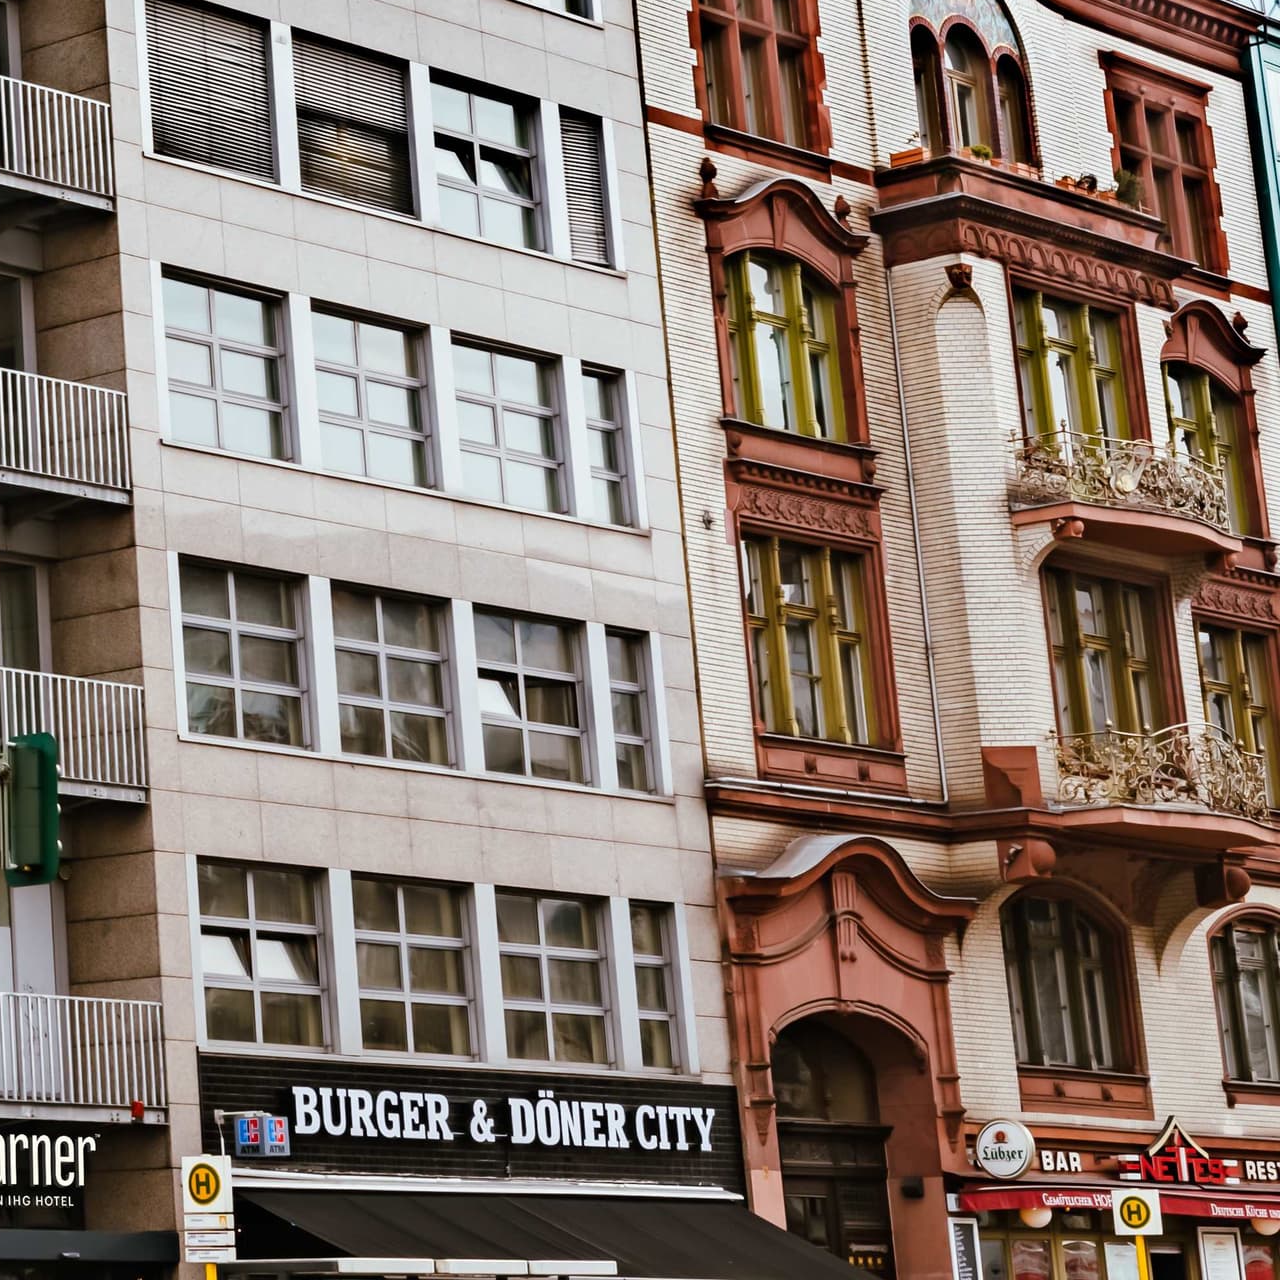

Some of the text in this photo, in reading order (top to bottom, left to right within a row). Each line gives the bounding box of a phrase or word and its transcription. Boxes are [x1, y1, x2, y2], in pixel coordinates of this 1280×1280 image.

[291, 1085, 716, 1152] BURGER & DÖNER CITY
[240, 1144, 260, 1154] ATM
[269, 1144, 286, 1154] ATM
[982, 1146, 1024, 1162] Lübzer
[1041, 1150, 1082, 1173] BAR
[195, 1173, 211, 1195] H
[8, 1195, 31, 1207] IHG
[36, 1196, 74, 1207] HOTEL
[1126, 1204, 1142, 1221] H
